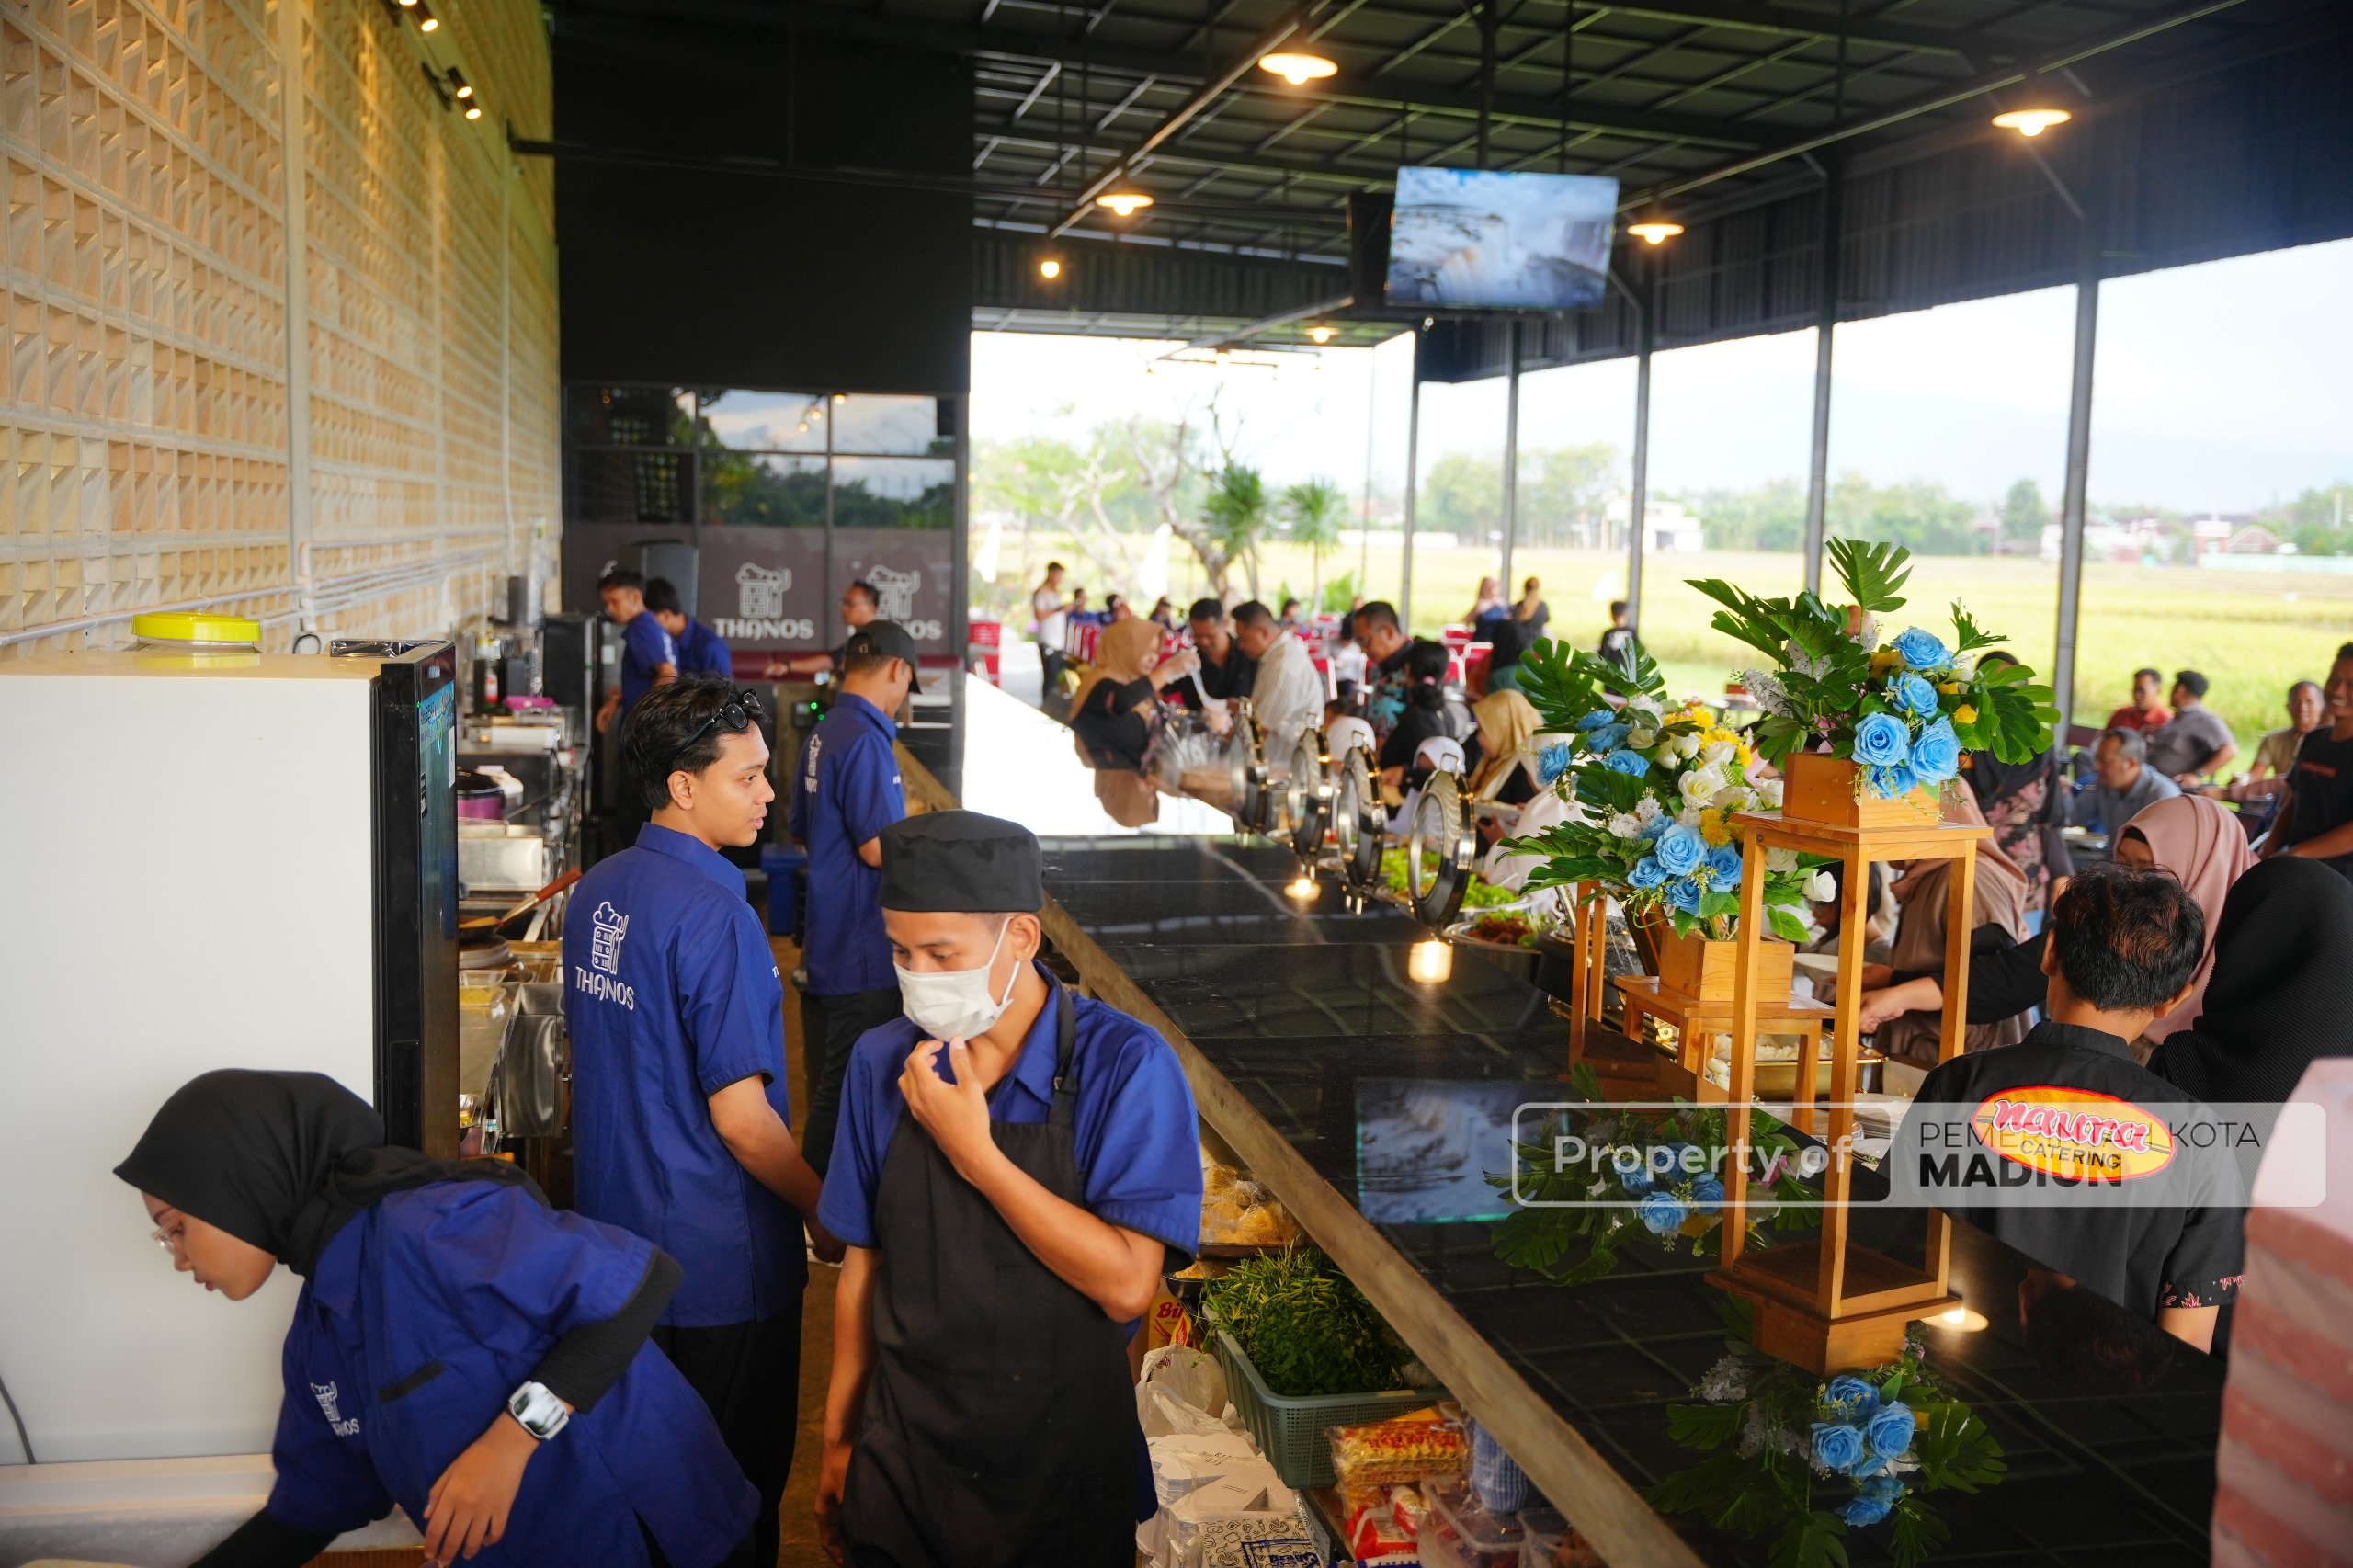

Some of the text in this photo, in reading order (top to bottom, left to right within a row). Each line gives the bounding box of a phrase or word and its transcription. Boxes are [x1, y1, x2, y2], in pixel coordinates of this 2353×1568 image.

[713, 618, 814, 641] THANOS
[575, 966, 634, 1010] THANOS
[1993, 1099, 2150, 1153] naura
[2020, 1139, 2121, 1169] CATERING
